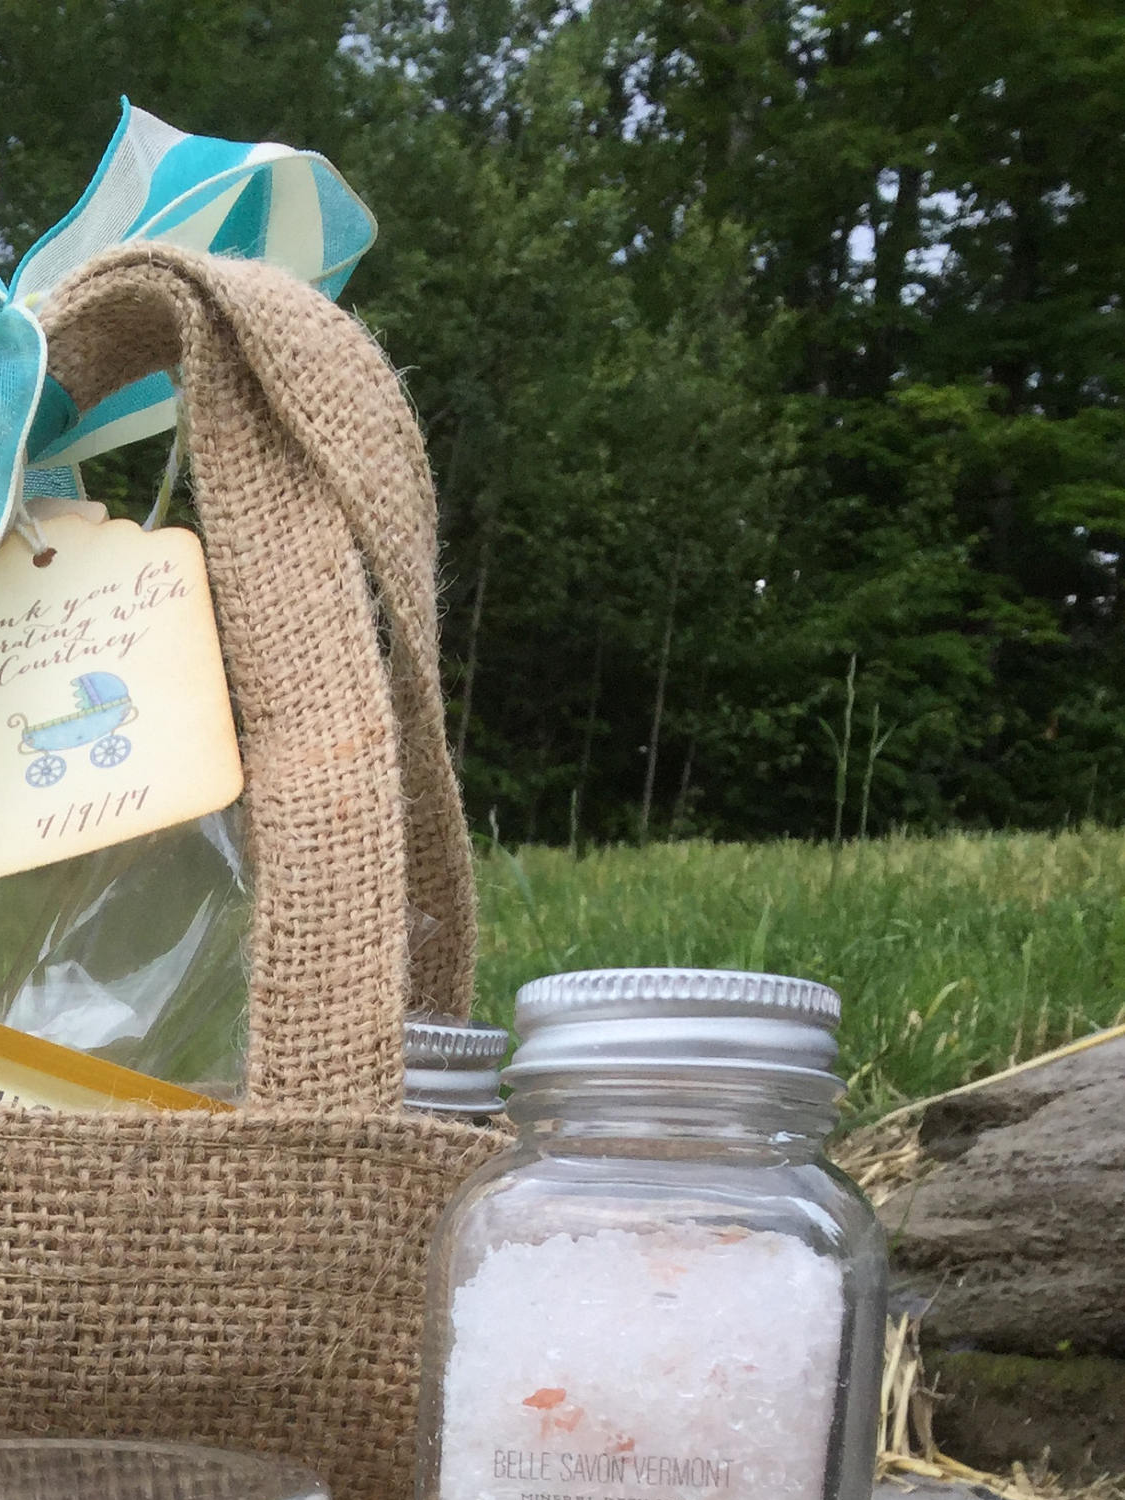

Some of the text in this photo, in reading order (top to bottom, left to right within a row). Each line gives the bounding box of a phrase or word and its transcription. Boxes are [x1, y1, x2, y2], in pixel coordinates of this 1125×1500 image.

[60, 583, 122, 624] you
[134, 560, 179, 596] for
[113, 582, 193, 621] with
[494, 1449, 735, 1488] BELLE SAVON VERMONT
